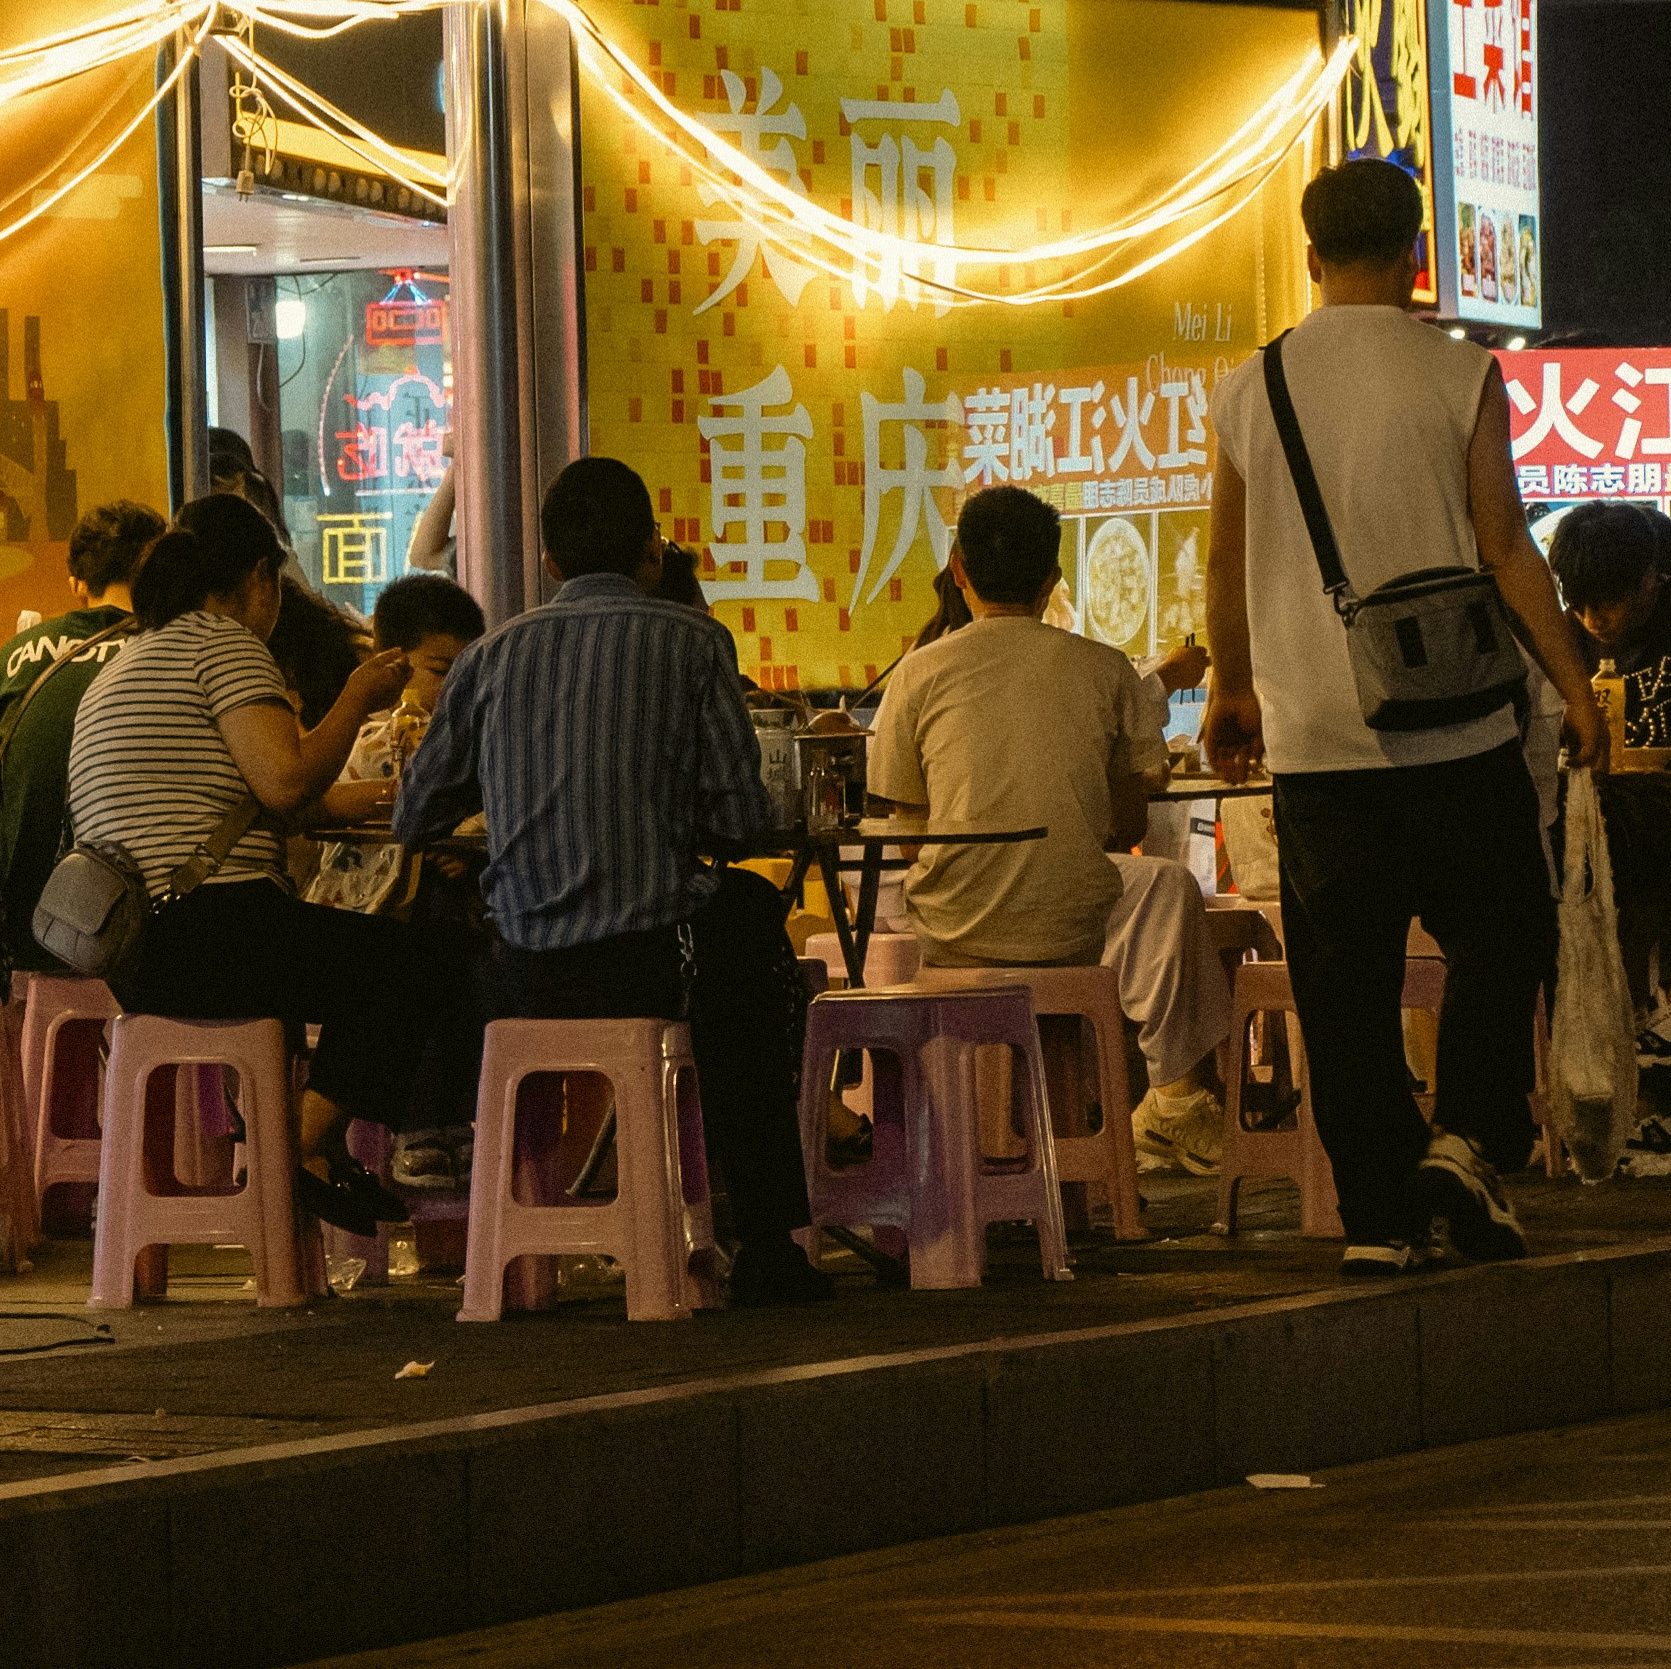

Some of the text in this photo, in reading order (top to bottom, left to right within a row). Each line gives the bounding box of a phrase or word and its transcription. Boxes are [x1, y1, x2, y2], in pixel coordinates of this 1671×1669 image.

[693, 66, 962, 318] 美丽
[1172, 302, 1233, 341] Mei Li
[696, 365, 970, 618] 重庆
